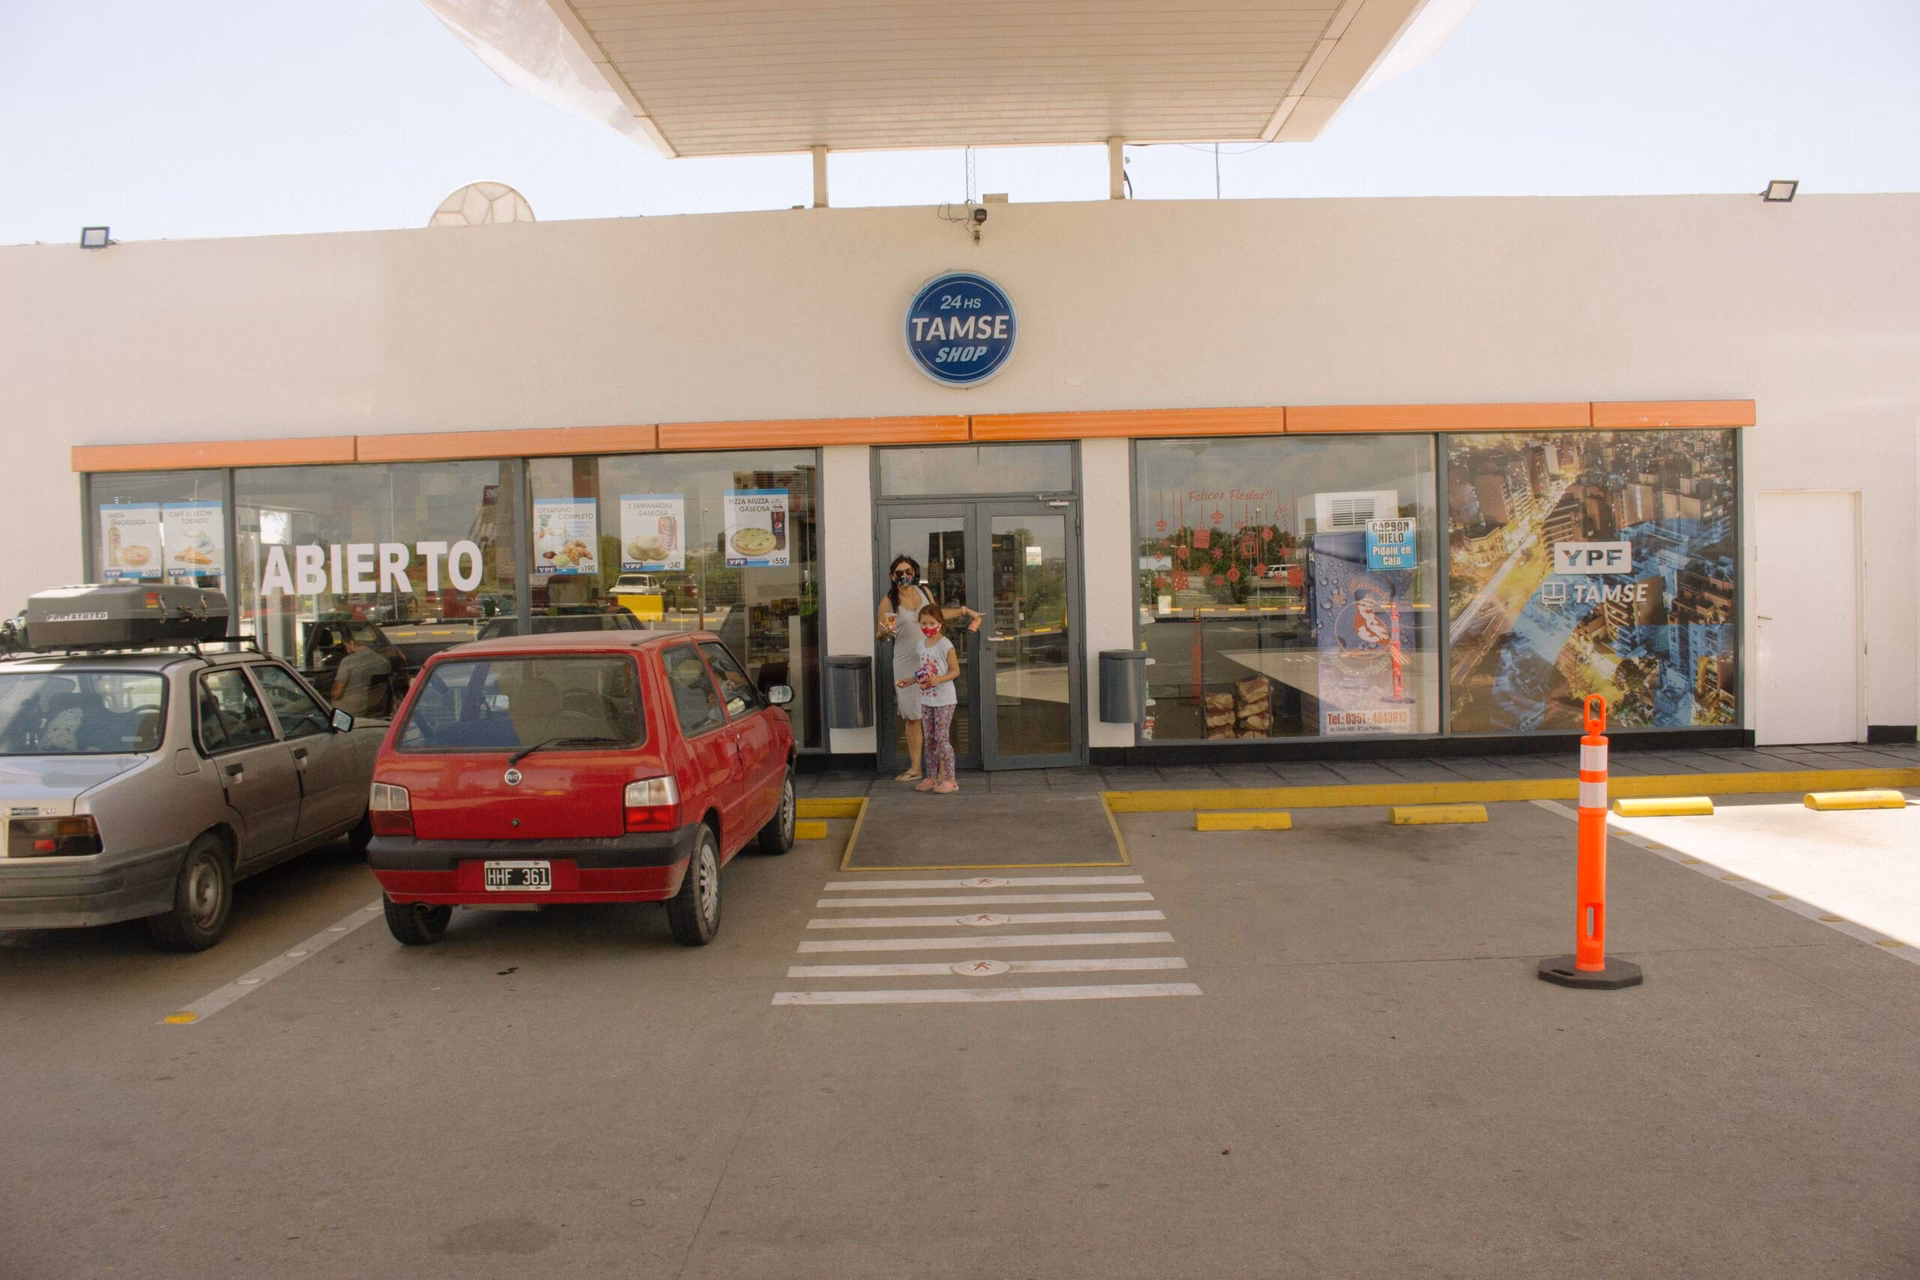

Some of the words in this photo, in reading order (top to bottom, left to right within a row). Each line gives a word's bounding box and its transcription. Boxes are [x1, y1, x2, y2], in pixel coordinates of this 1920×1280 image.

[940, 294, 962, 310] 24
[963, 298, 982, 309] HS
[911, 315, 1010, 342] TAMSE
[935, 346, 988, 363] SHOP
[1187, 489, 1225, 502] Felices
[538, 506, 572, 514] DESAYUNO
[558, 512, 595, 520] COMPLETO
[1372, 521, 1410, 533] CARBON
[1378, 532, 1405, 544] HIELO
[1400, 546, 1411, 555] en
[772, 557, 787, 565] $550
[1383, 556, 1402, 566] Caja
[1561, 549, 1623, 566] YPF
[260, 540, 483, 596] ABIERTO
[1573, 583, 1649, 604] TAMSE
[1328, 713, 1345, 725] Tel.:
[1345, 713, 1366, 725] 0351
[487, 868, 514, 885] HHF
[521, 868, 549, 885] 361
